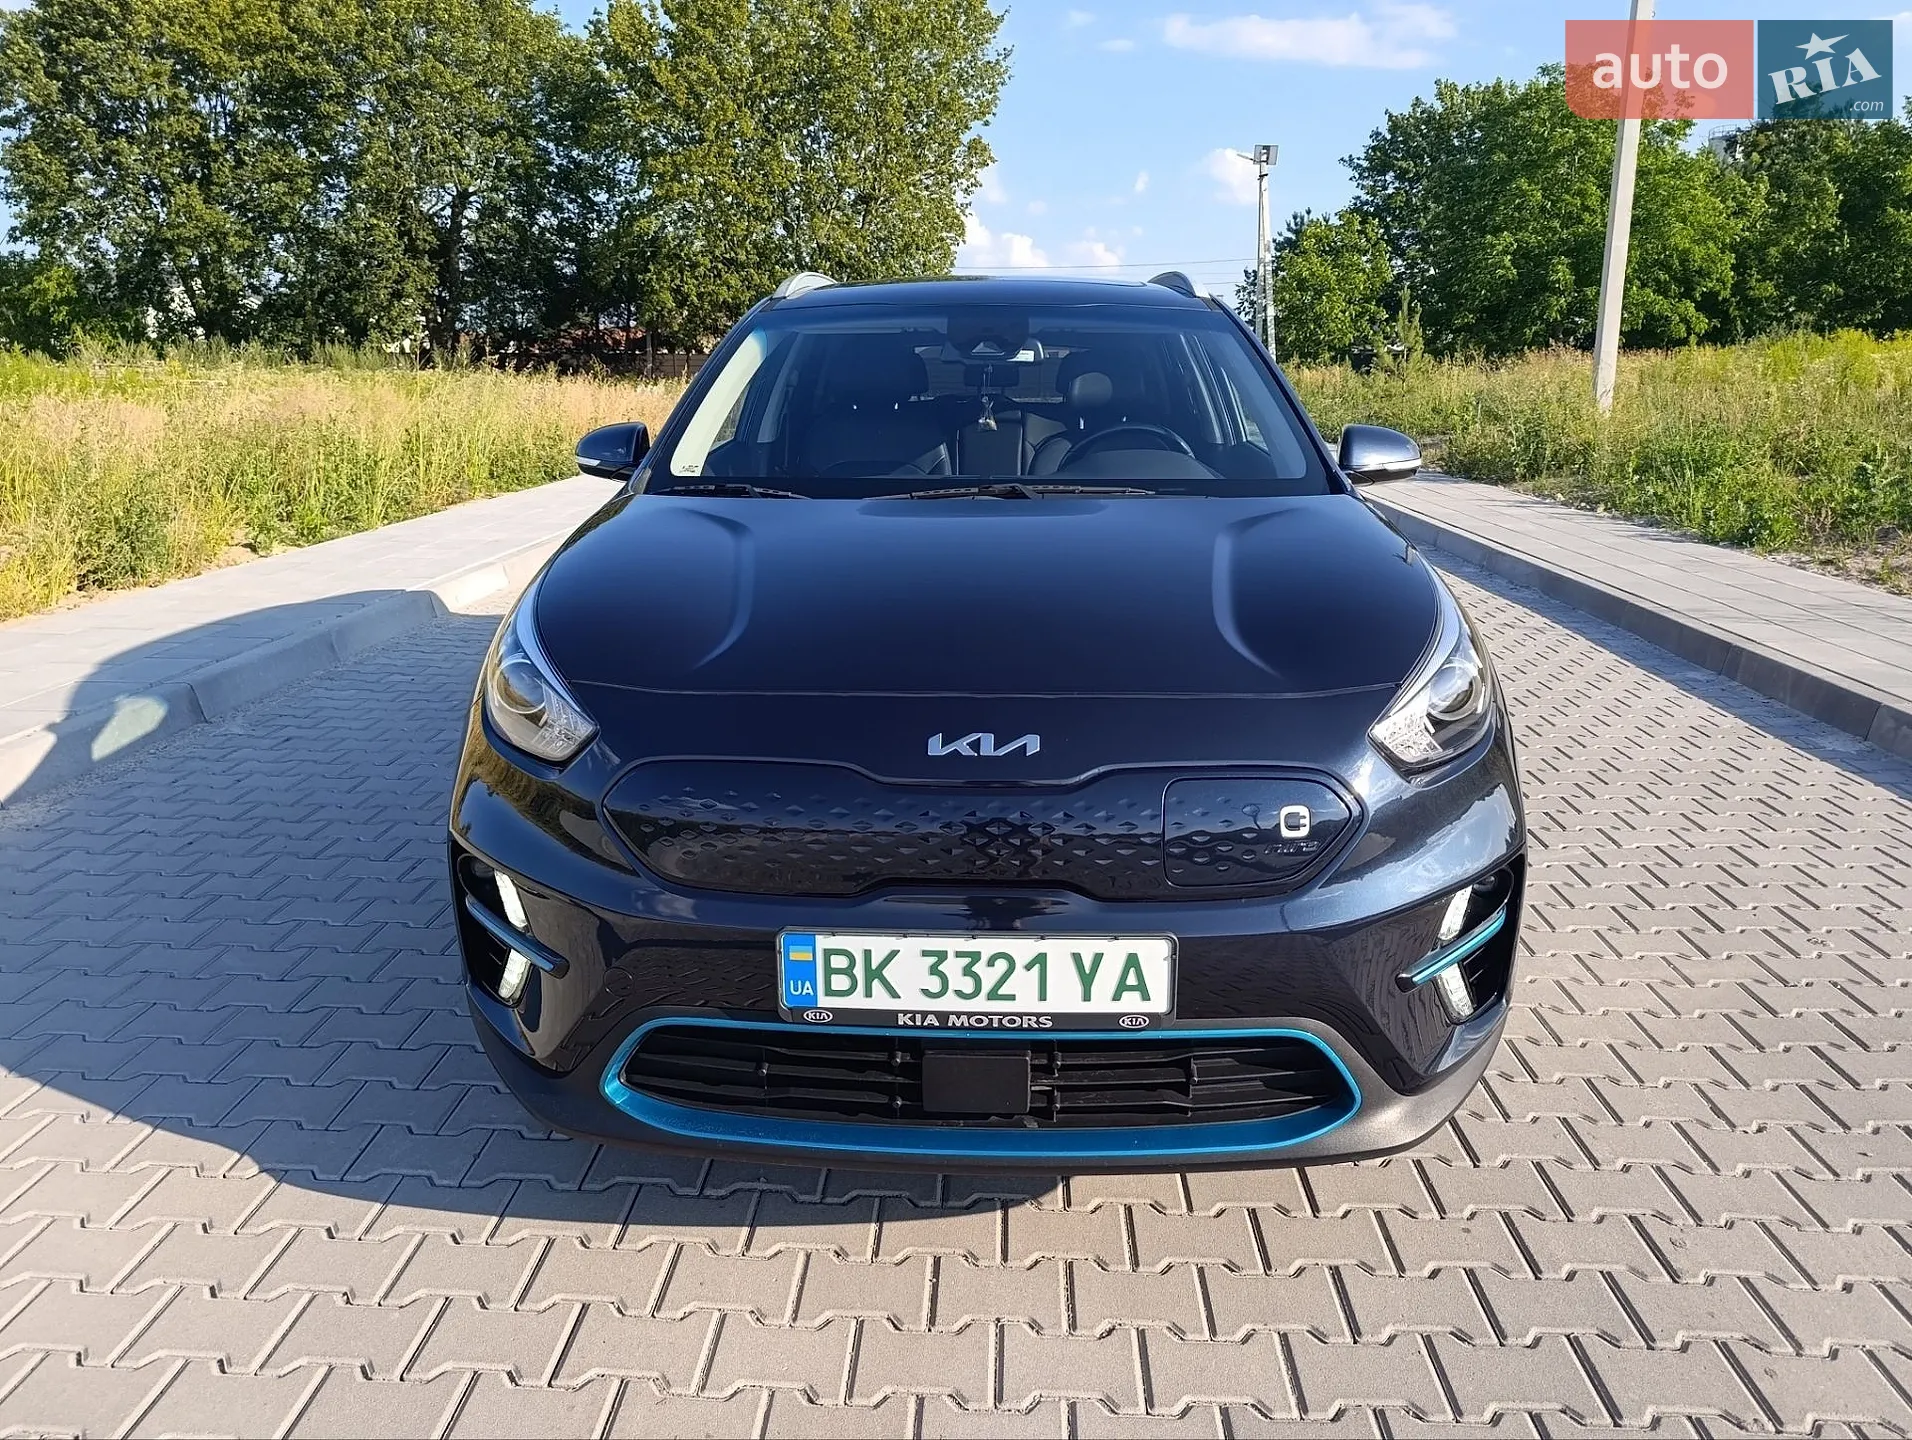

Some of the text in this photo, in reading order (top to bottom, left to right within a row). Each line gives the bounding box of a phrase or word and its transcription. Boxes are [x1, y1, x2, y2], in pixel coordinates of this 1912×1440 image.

[927, 732, 1040, 757] KIA
[822, 948, 1151, 1003] BK 3321 YA
[789, 979, 814, 996] UA
[897, 1013, 1053, 1028] KIA MOTORS
